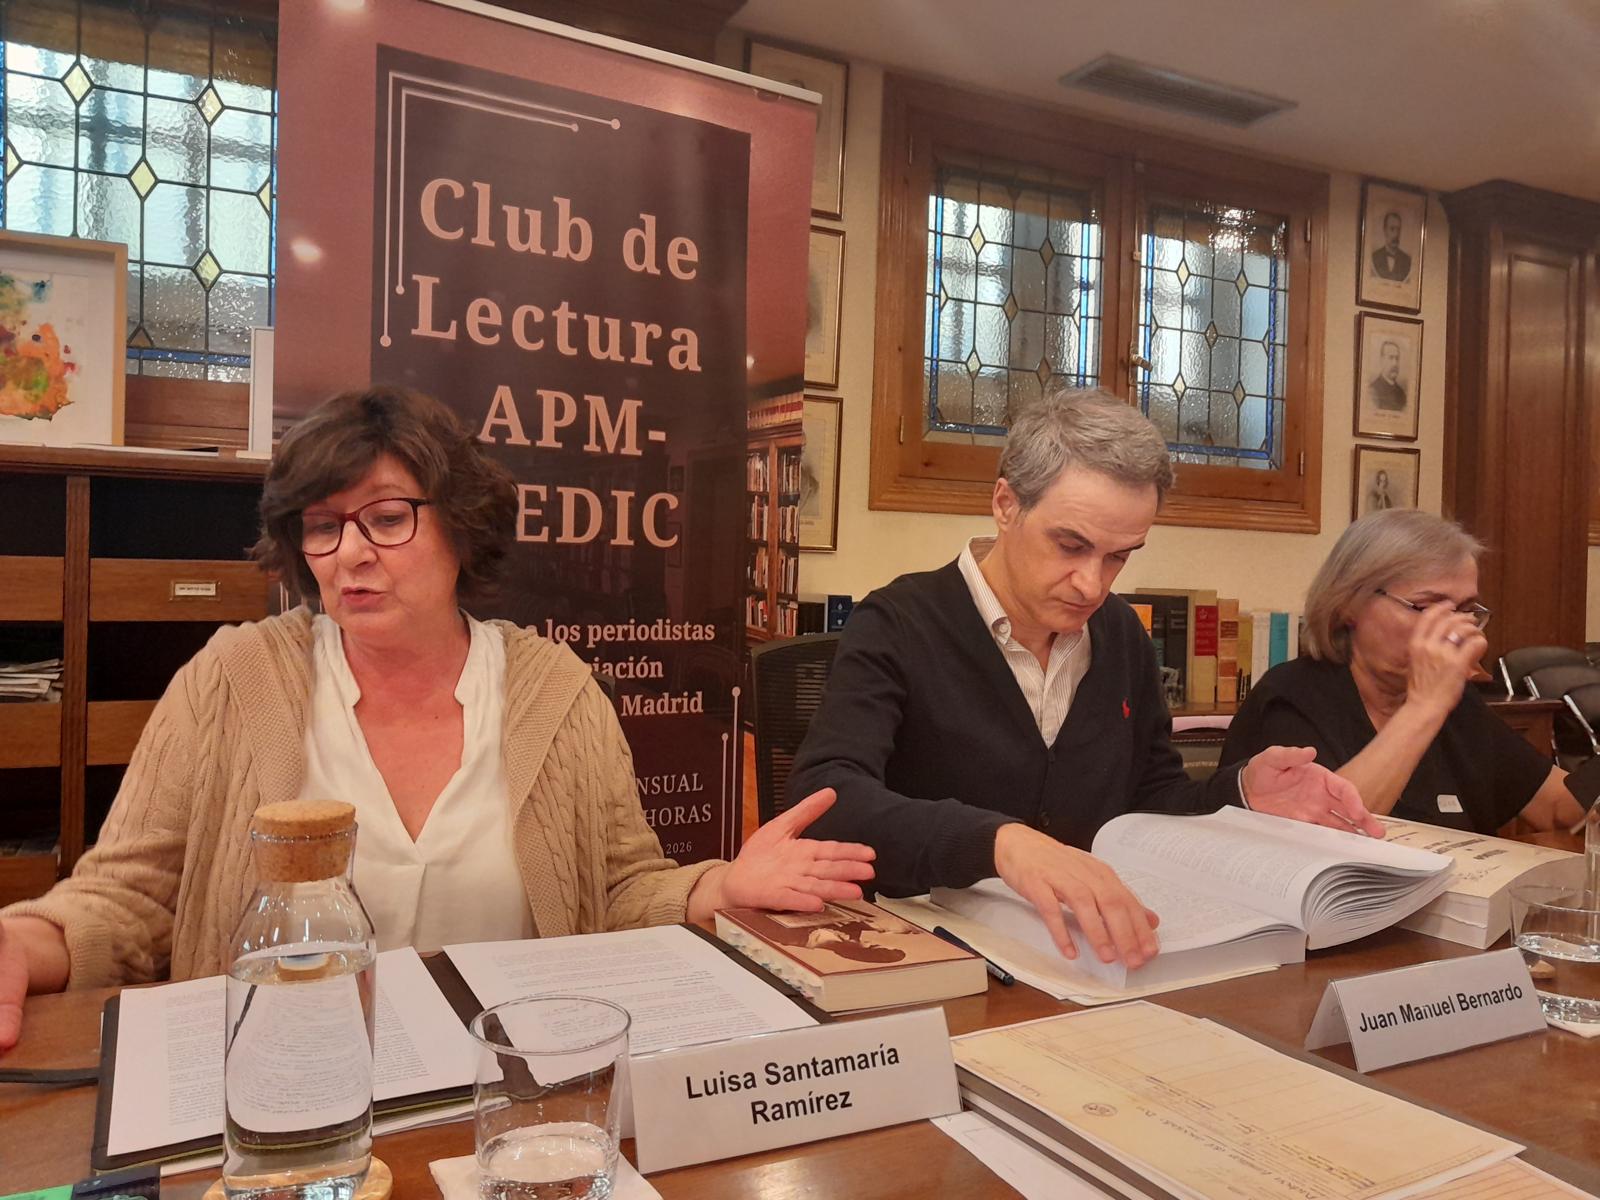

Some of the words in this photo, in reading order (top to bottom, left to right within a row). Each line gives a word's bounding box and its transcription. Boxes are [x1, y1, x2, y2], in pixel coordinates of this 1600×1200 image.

[420, 177, 593, 262] Club
[622, 213, 699, 280] de
[411, 273, 702, 371] Lectura
[477, 385, 666, 456] APM-
[516, 484, 678, 548] EDIC
[545, 618, 581, 641] los
[586, 618, 716, 648] periodistas
[590, 655, 664, 679] iación
[620, 691, 704, 717] Madrid
[635, 773, 704, 795] NSUAL
[643, 803, 712, 827] HORAS
[666, 841, 692, 854] 2026
[1359, 1012, 1398, 1033] Juan
[1399, 996, 1456, 1024] Manuel
[1456, 983, 1523, 1012] Bernardo
[686, 1070, 757, 1099] Luisa
[764, 1044, 900, 1086] Santamaría
[751, 1089, 853, 1125] Ramírez
